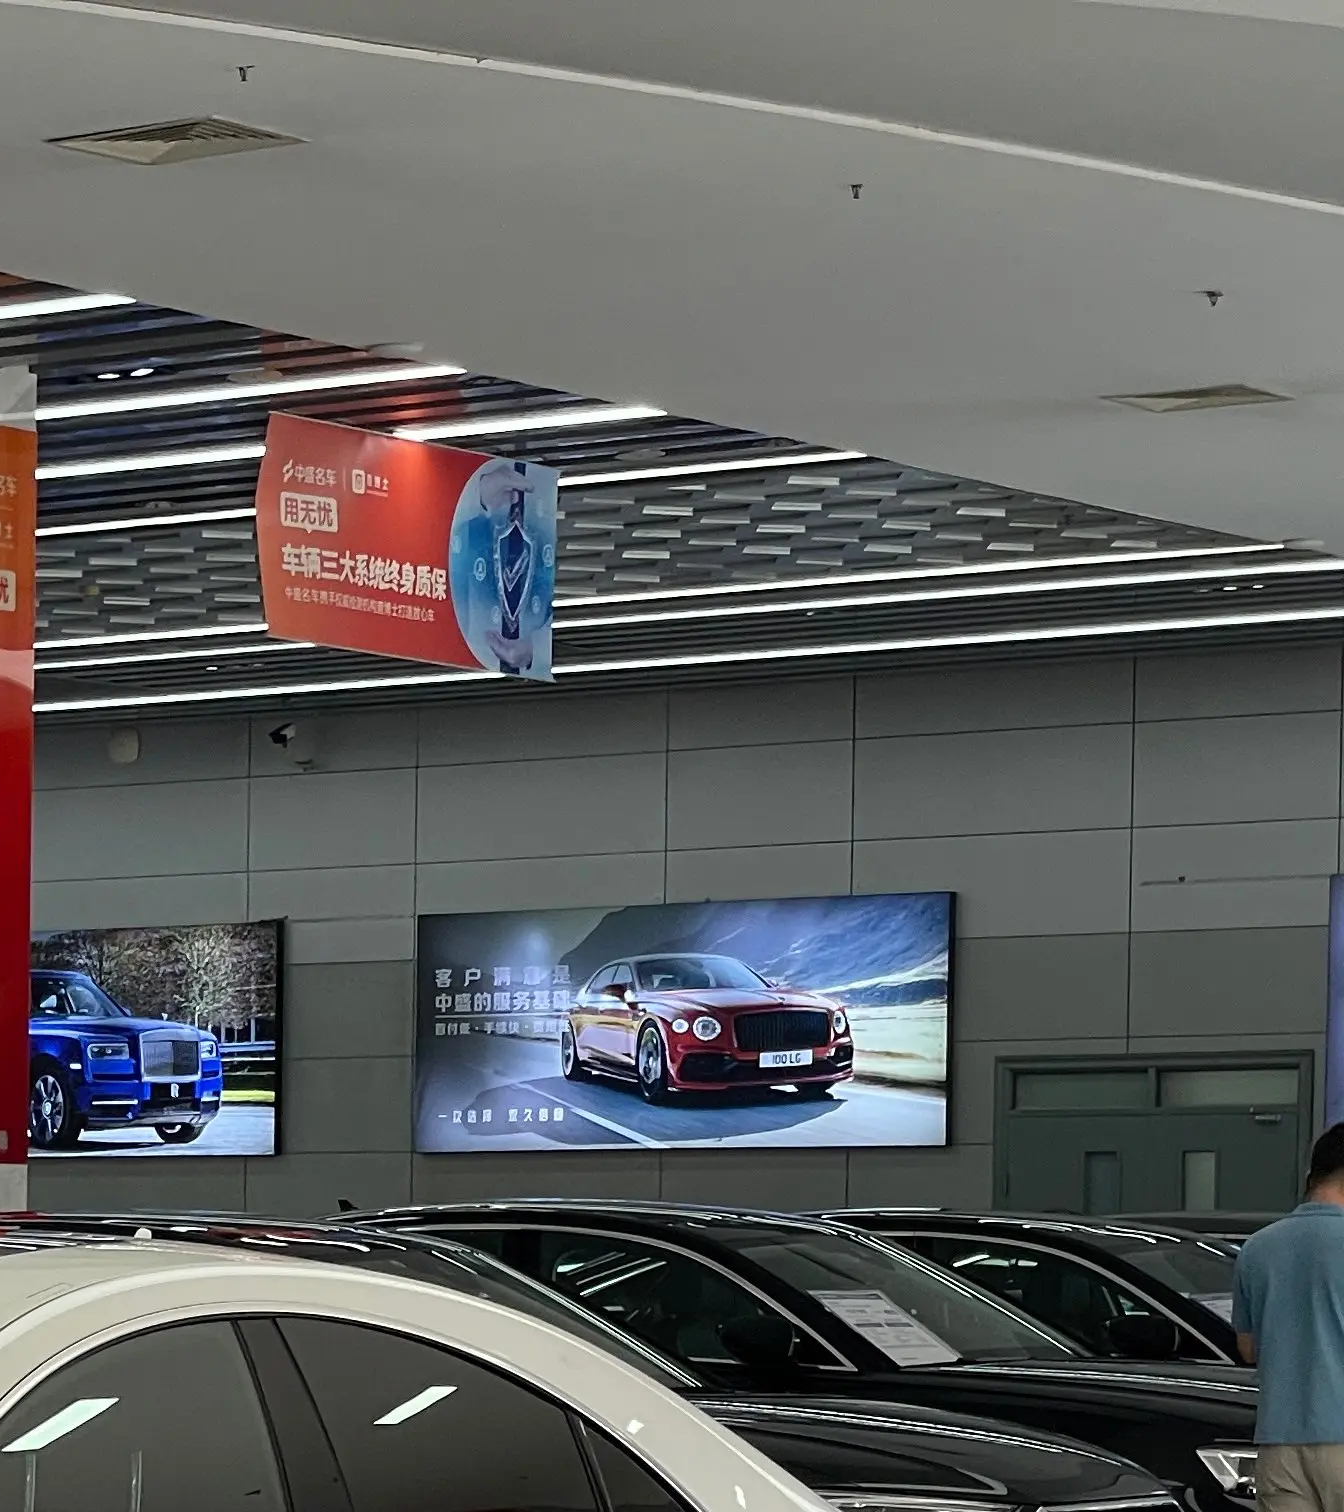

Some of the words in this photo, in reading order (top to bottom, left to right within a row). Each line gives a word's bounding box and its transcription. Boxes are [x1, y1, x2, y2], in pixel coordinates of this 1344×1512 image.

[284, 497, 333, 527] 用无忧
[281, 542, 447, 601] 车辆三大系统终身质保
